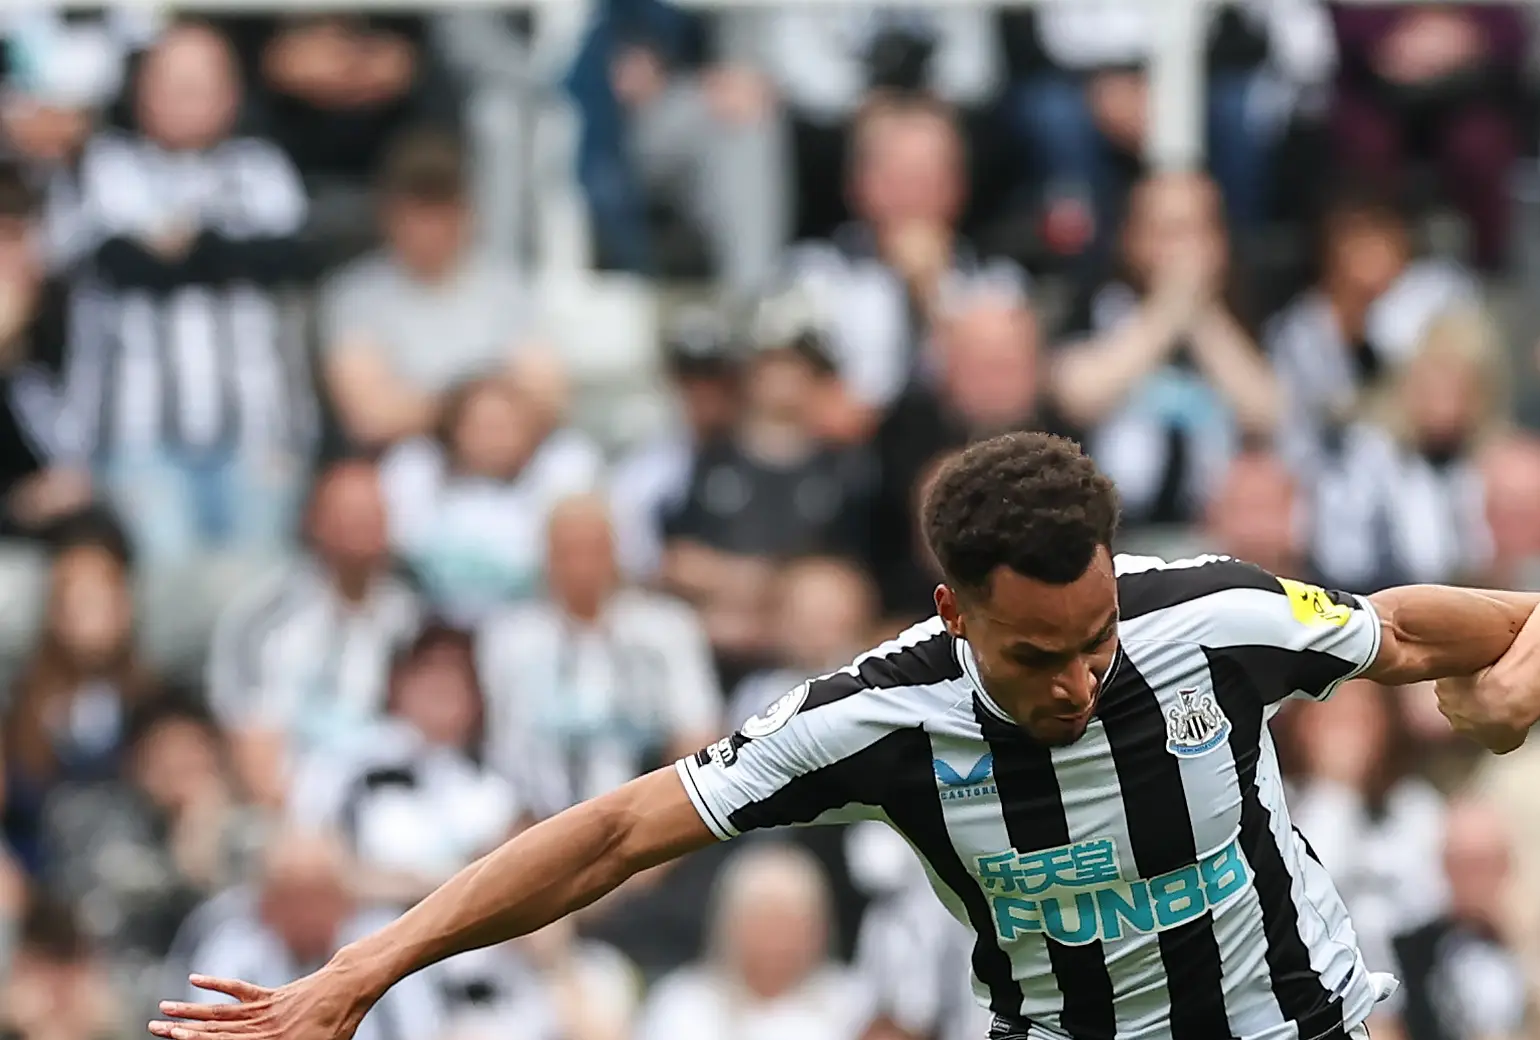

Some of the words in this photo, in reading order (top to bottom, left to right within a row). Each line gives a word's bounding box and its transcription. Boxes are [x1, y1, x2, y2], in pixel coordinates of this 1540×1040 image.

[978, 839, 1120, 895] 乐天堂
[993, 841, 1248, 943] FUN88
